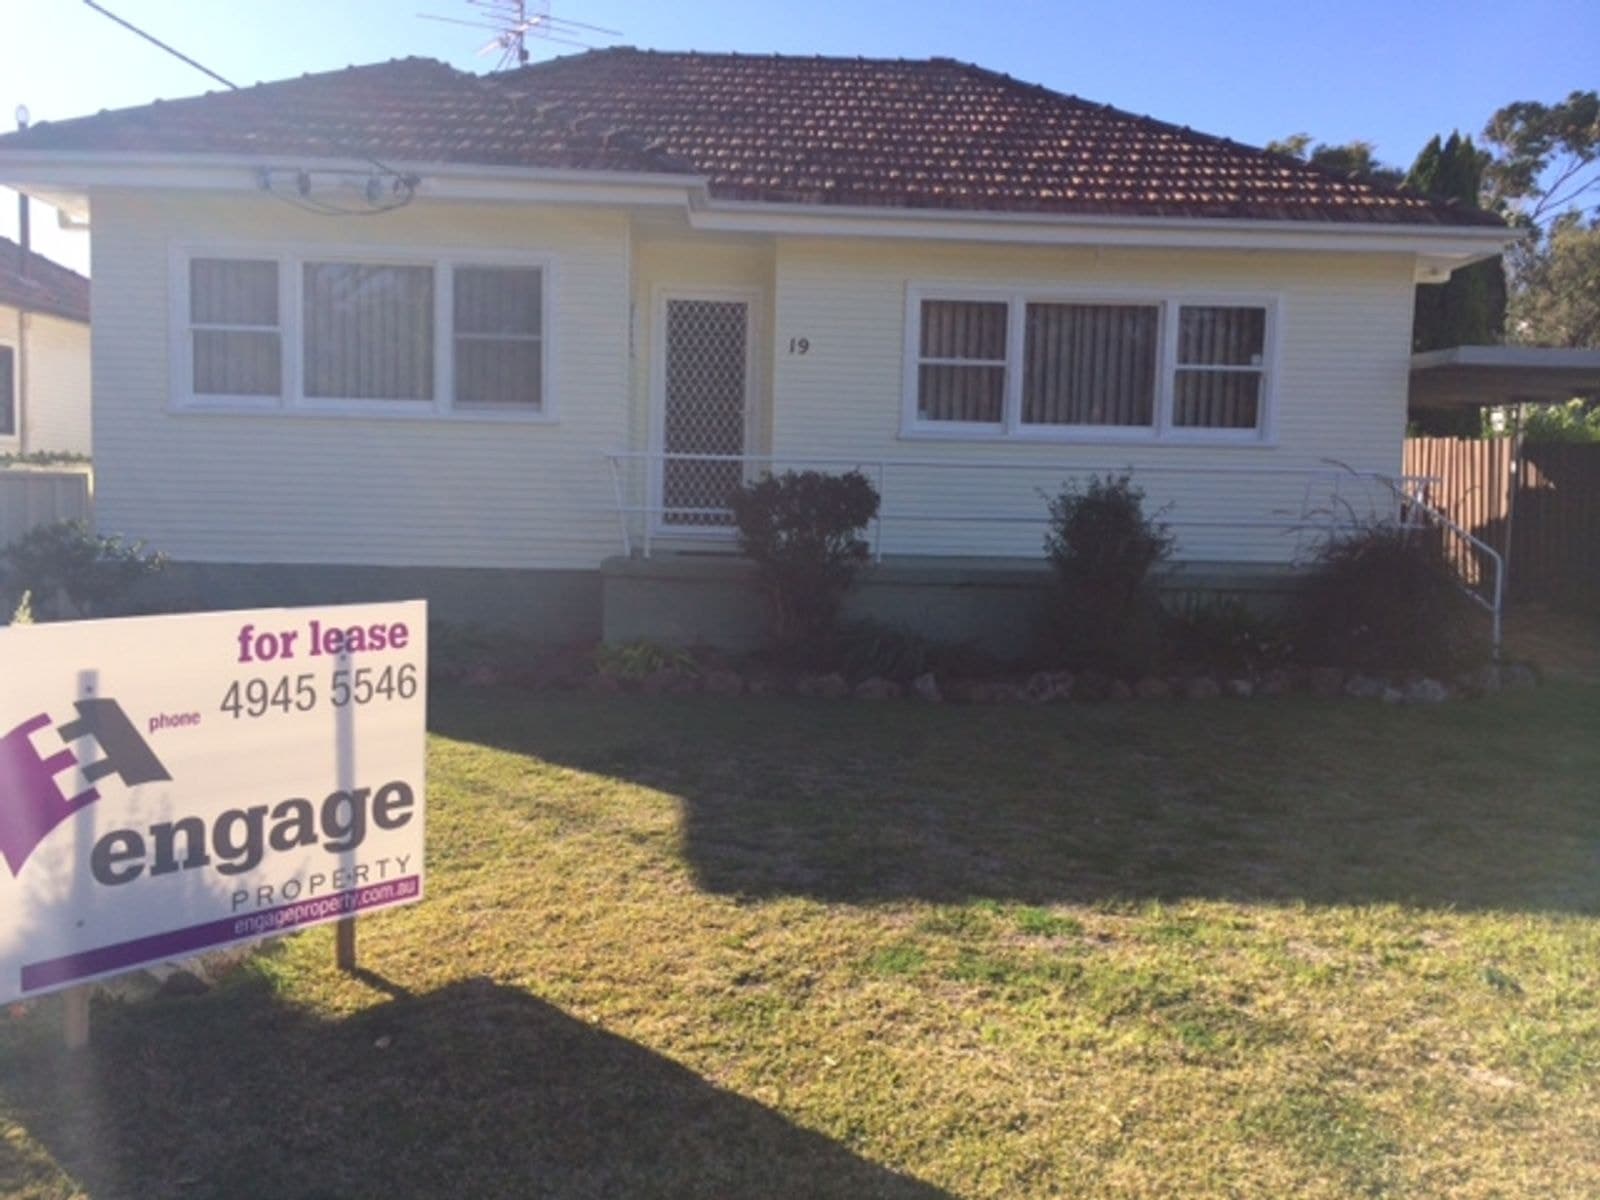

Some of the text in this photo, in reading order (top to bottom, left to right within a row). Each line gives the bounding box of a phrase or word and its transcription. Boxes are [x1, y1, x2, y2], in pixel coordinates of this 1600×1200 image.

[789, 337, 810, 355] 19
[237, 620, 409, 662] for lease
[220, 662, 417, 719] 4945 5546
[149, 710, 201, 734] phone
[90, 780, 414, 886] engage
[231, 855, 412, 912] PROPERTY
[234, 880, 417, 934] engageproperty.com.au
